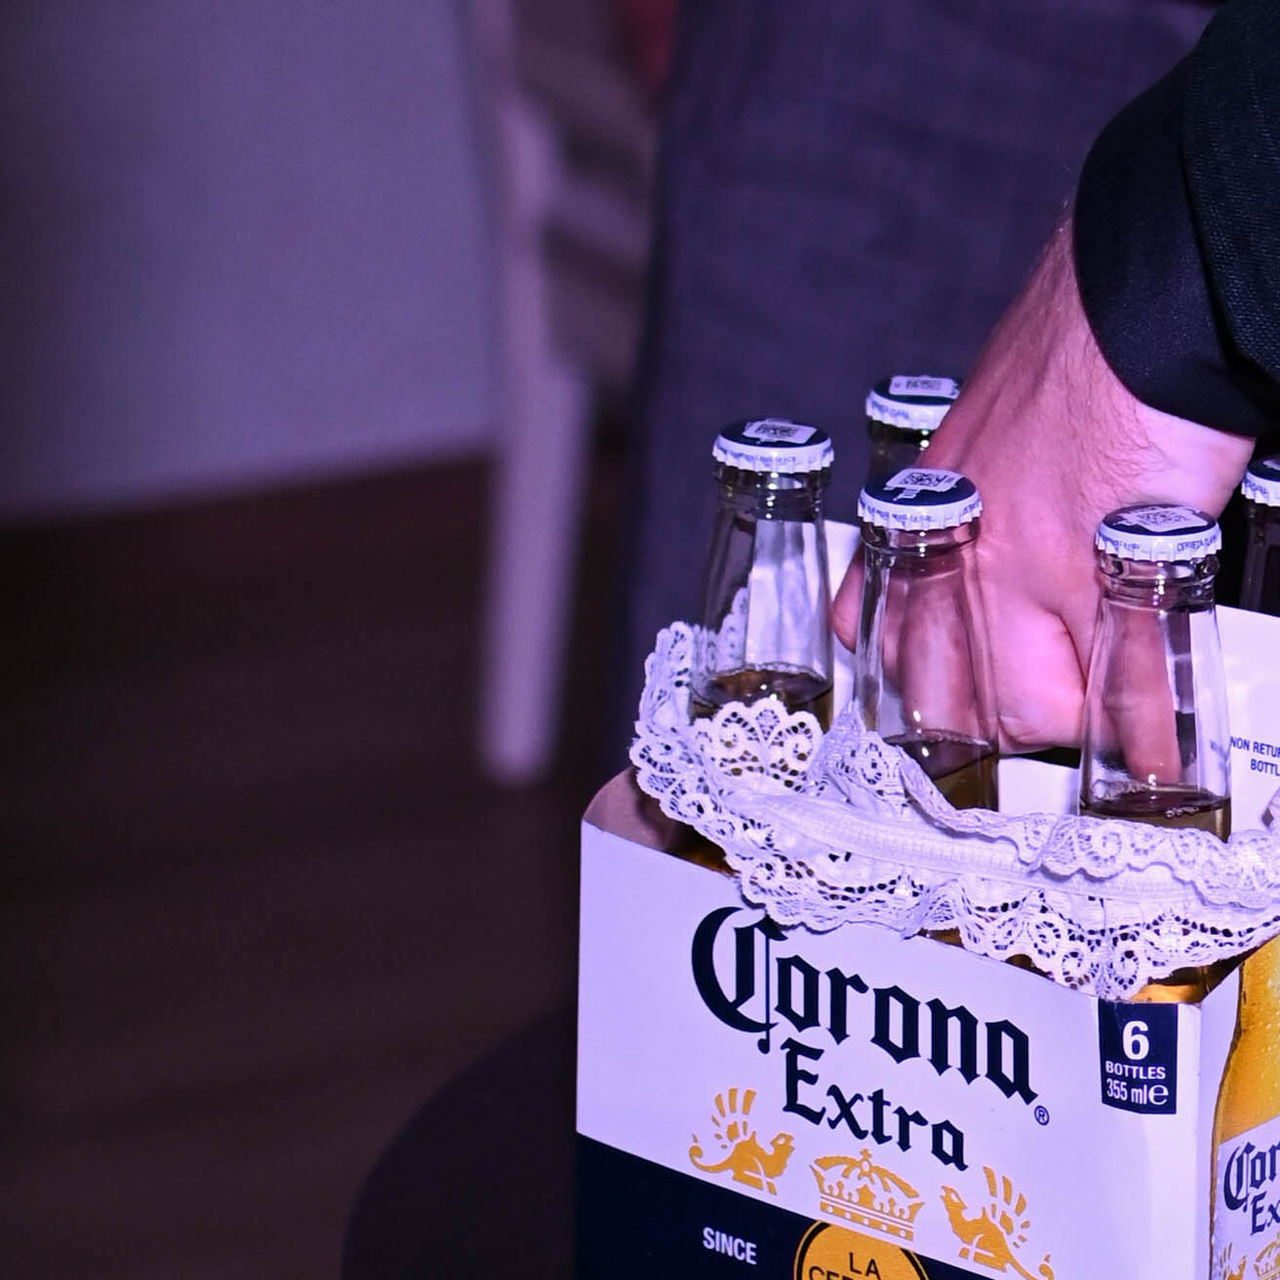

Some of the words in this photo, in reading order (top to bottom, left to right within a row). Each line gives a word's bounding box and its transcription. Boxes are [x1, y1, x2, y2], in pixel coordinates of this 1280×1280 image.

[1230, 735, 1250, 751] NON
[691, 906, 1039, 1106] Corona
[1122, 1020, 1150, 1061] 6
[1105, 1060, 1167, 1080] BOTTLES
[780, 1037, 969, 1171] Extra
[1106, 1078, 1128, 1101] 355
[702, 1226, 758, 1265] SINCE
[849, 1251, 882, 1280] LA
